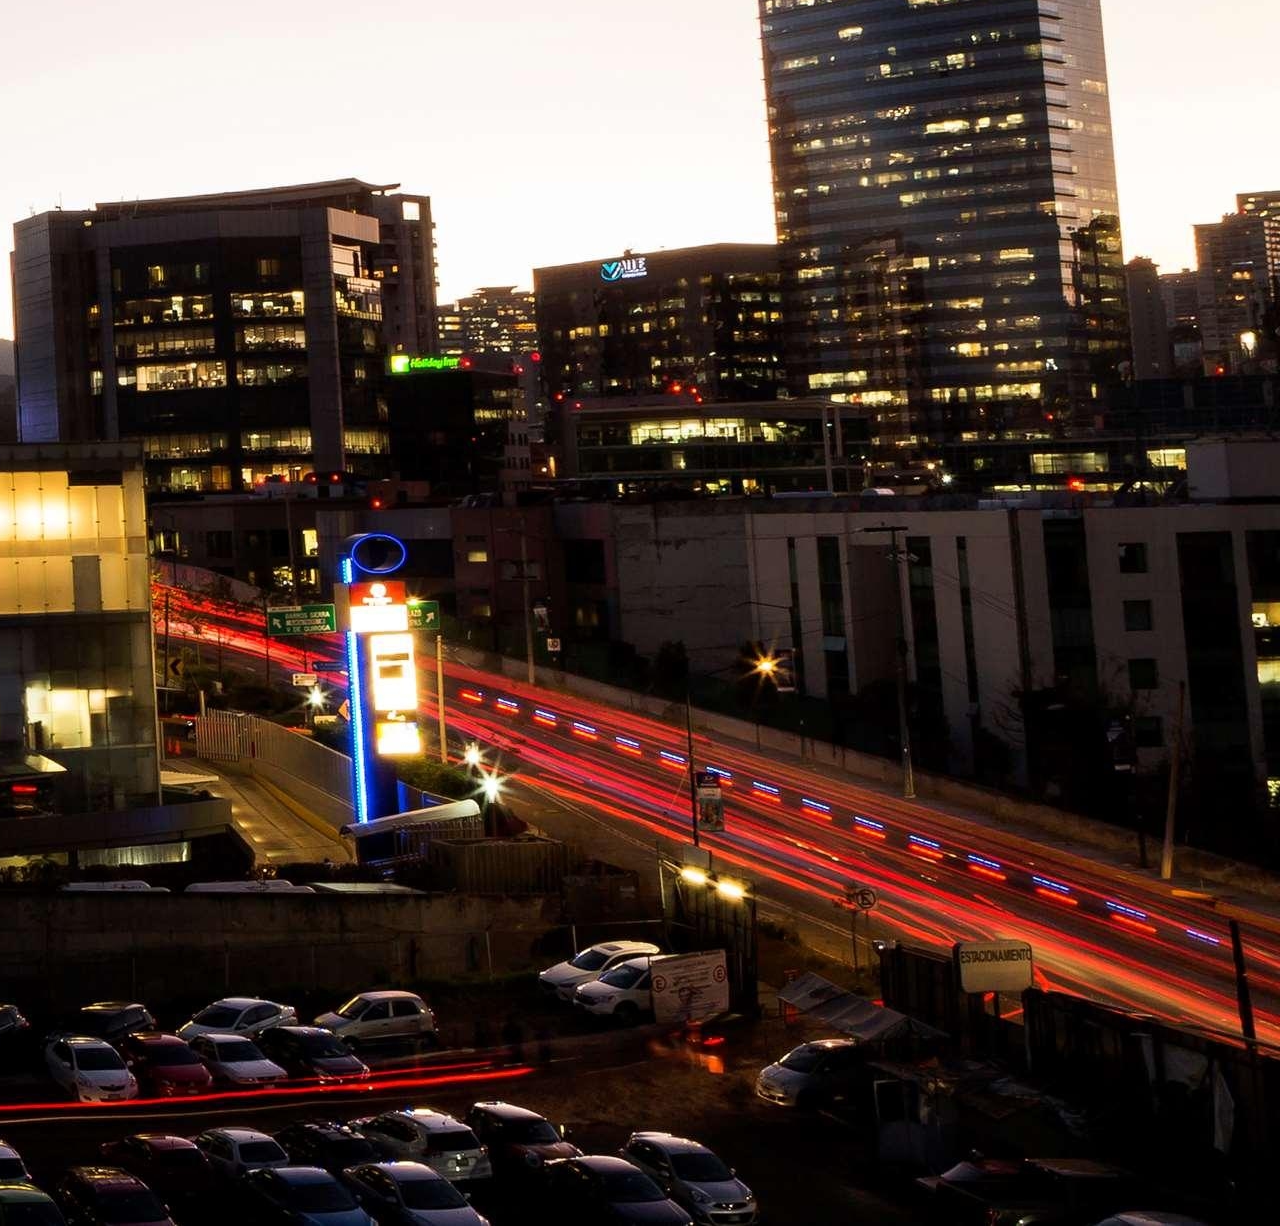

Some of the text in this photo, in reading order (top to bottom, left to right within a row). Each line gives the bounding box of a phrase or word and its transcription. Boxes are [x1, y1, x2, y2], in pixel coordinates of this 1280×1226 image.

[410, 356, 459, 369] Holiday Inn
[961, 948, 1032, 964] ESTACIONAMIENTO
